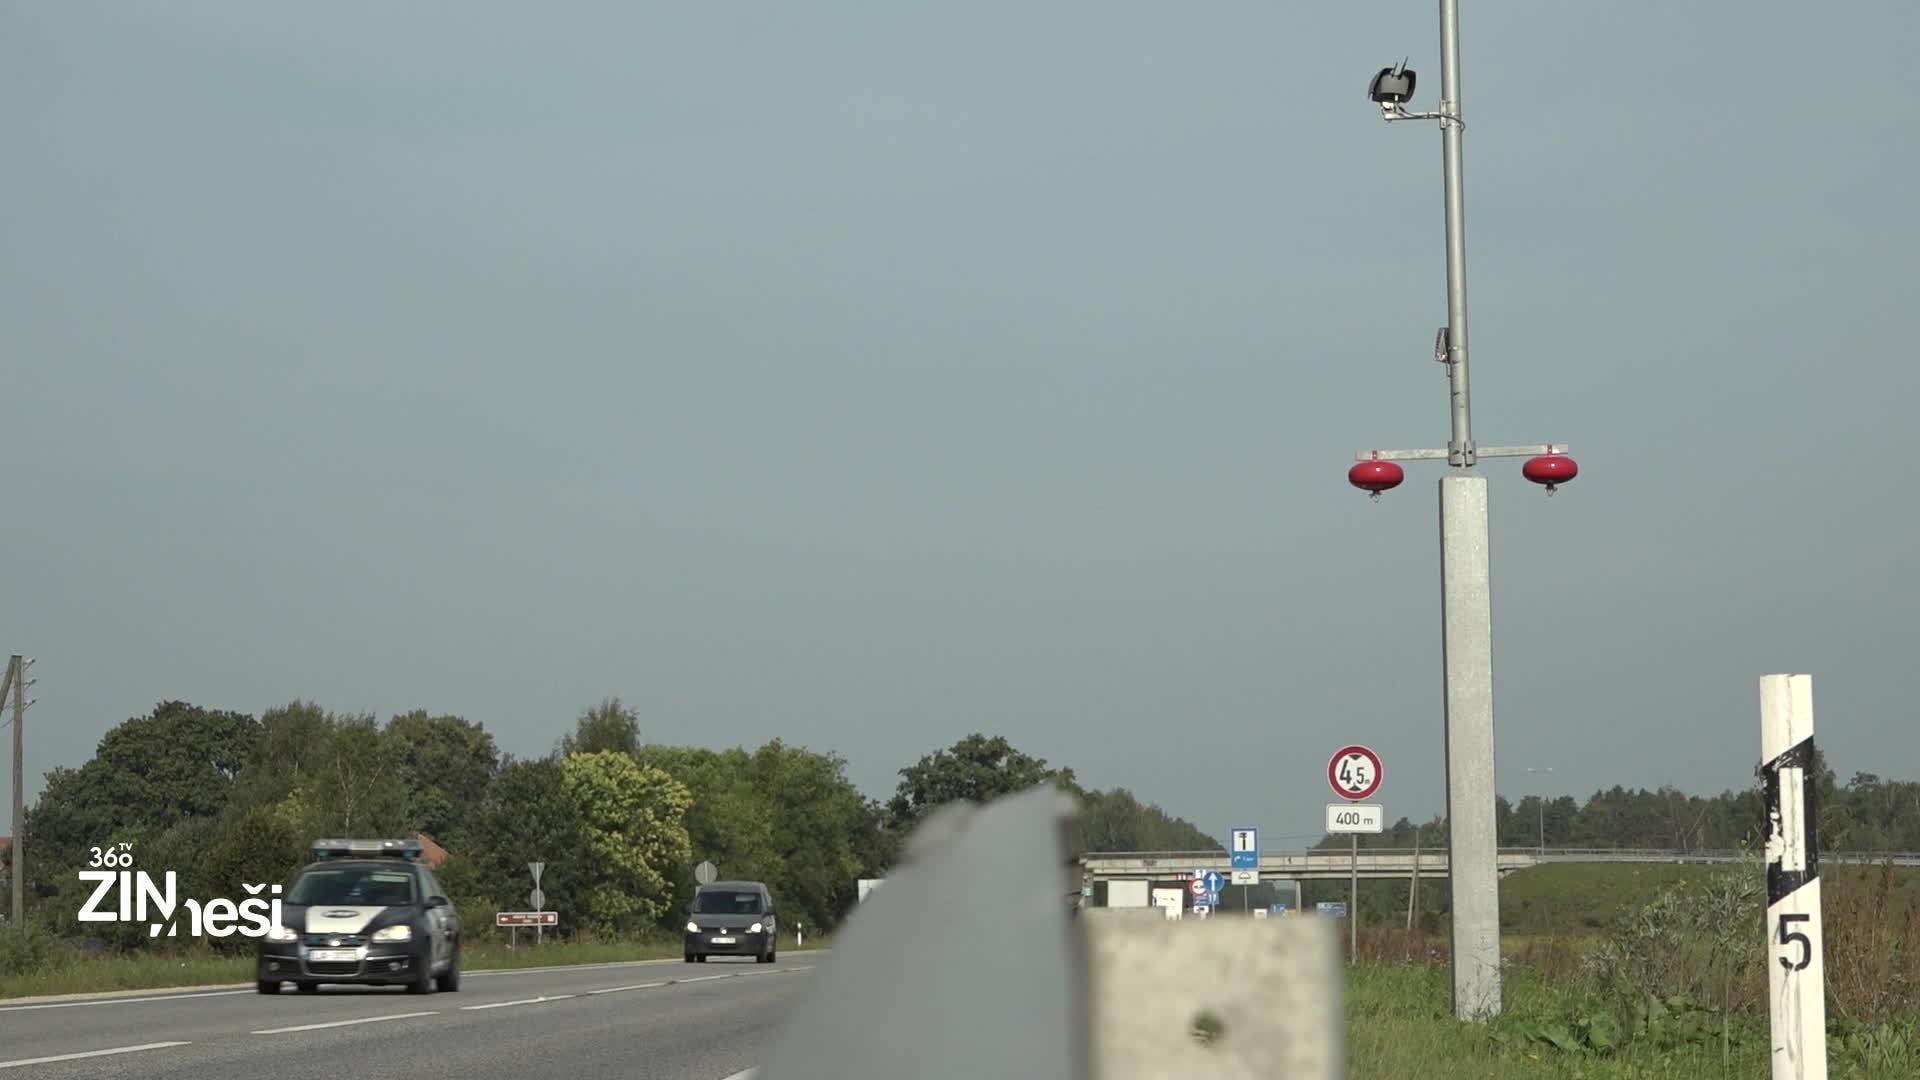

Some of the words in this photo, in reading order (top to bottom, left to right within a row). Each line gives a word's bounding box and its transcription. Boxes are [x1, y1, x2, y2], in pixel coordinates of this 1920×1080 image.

[1336, 812, 1360, 825] 400
[1363, 817, 1373, 825] m
[1779, 914, 1811, 972] 5
